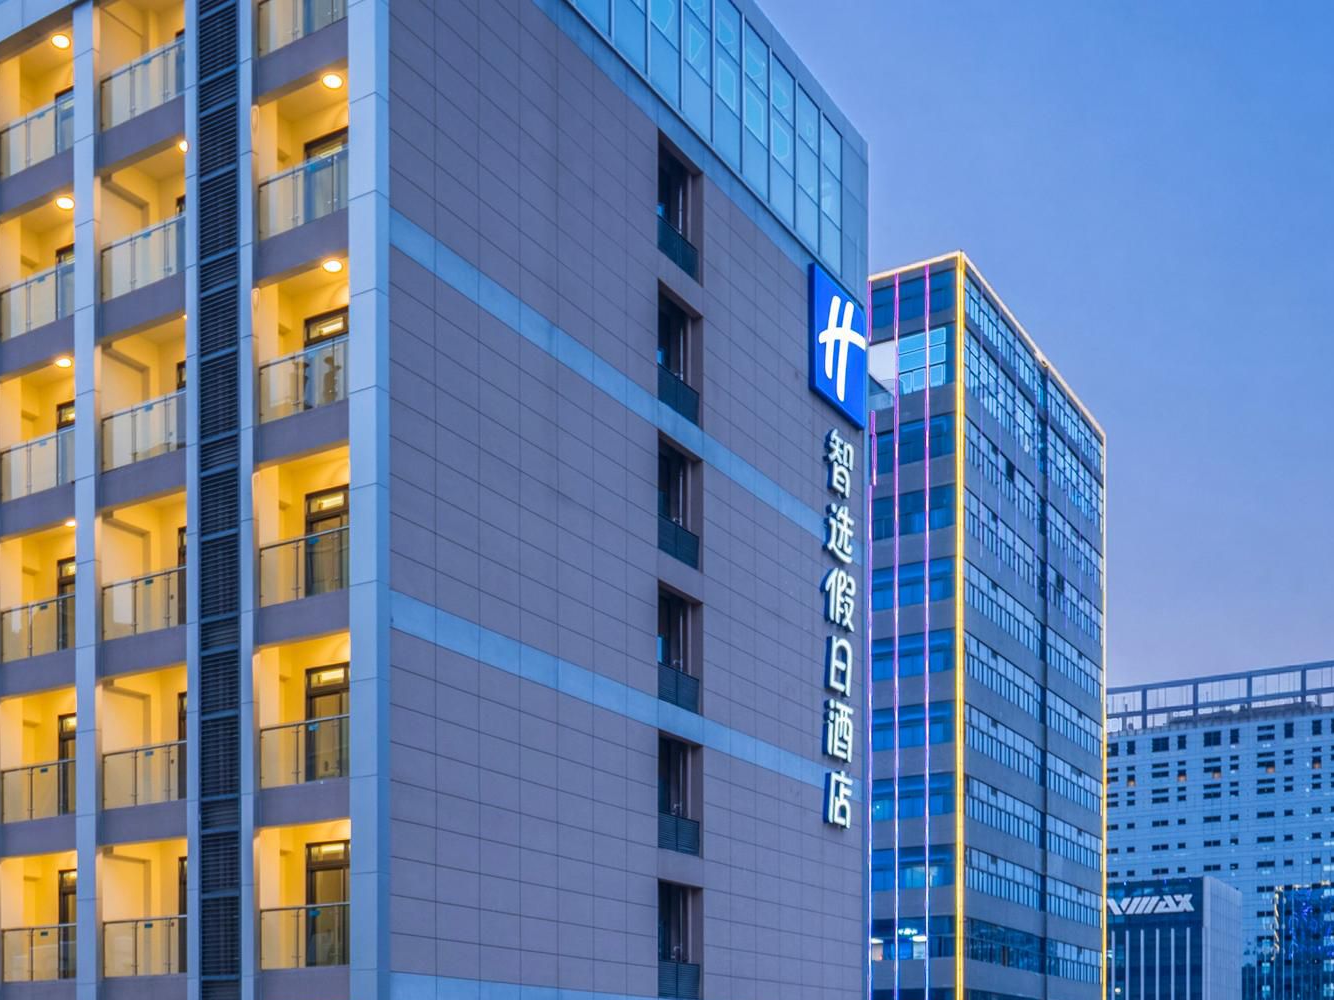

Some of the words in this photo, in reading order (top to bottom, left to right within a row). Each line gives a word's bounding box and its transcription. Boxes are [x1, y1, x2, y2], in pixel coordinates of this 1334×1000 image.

[824, 428, 856, 830] 智选假日酒店
